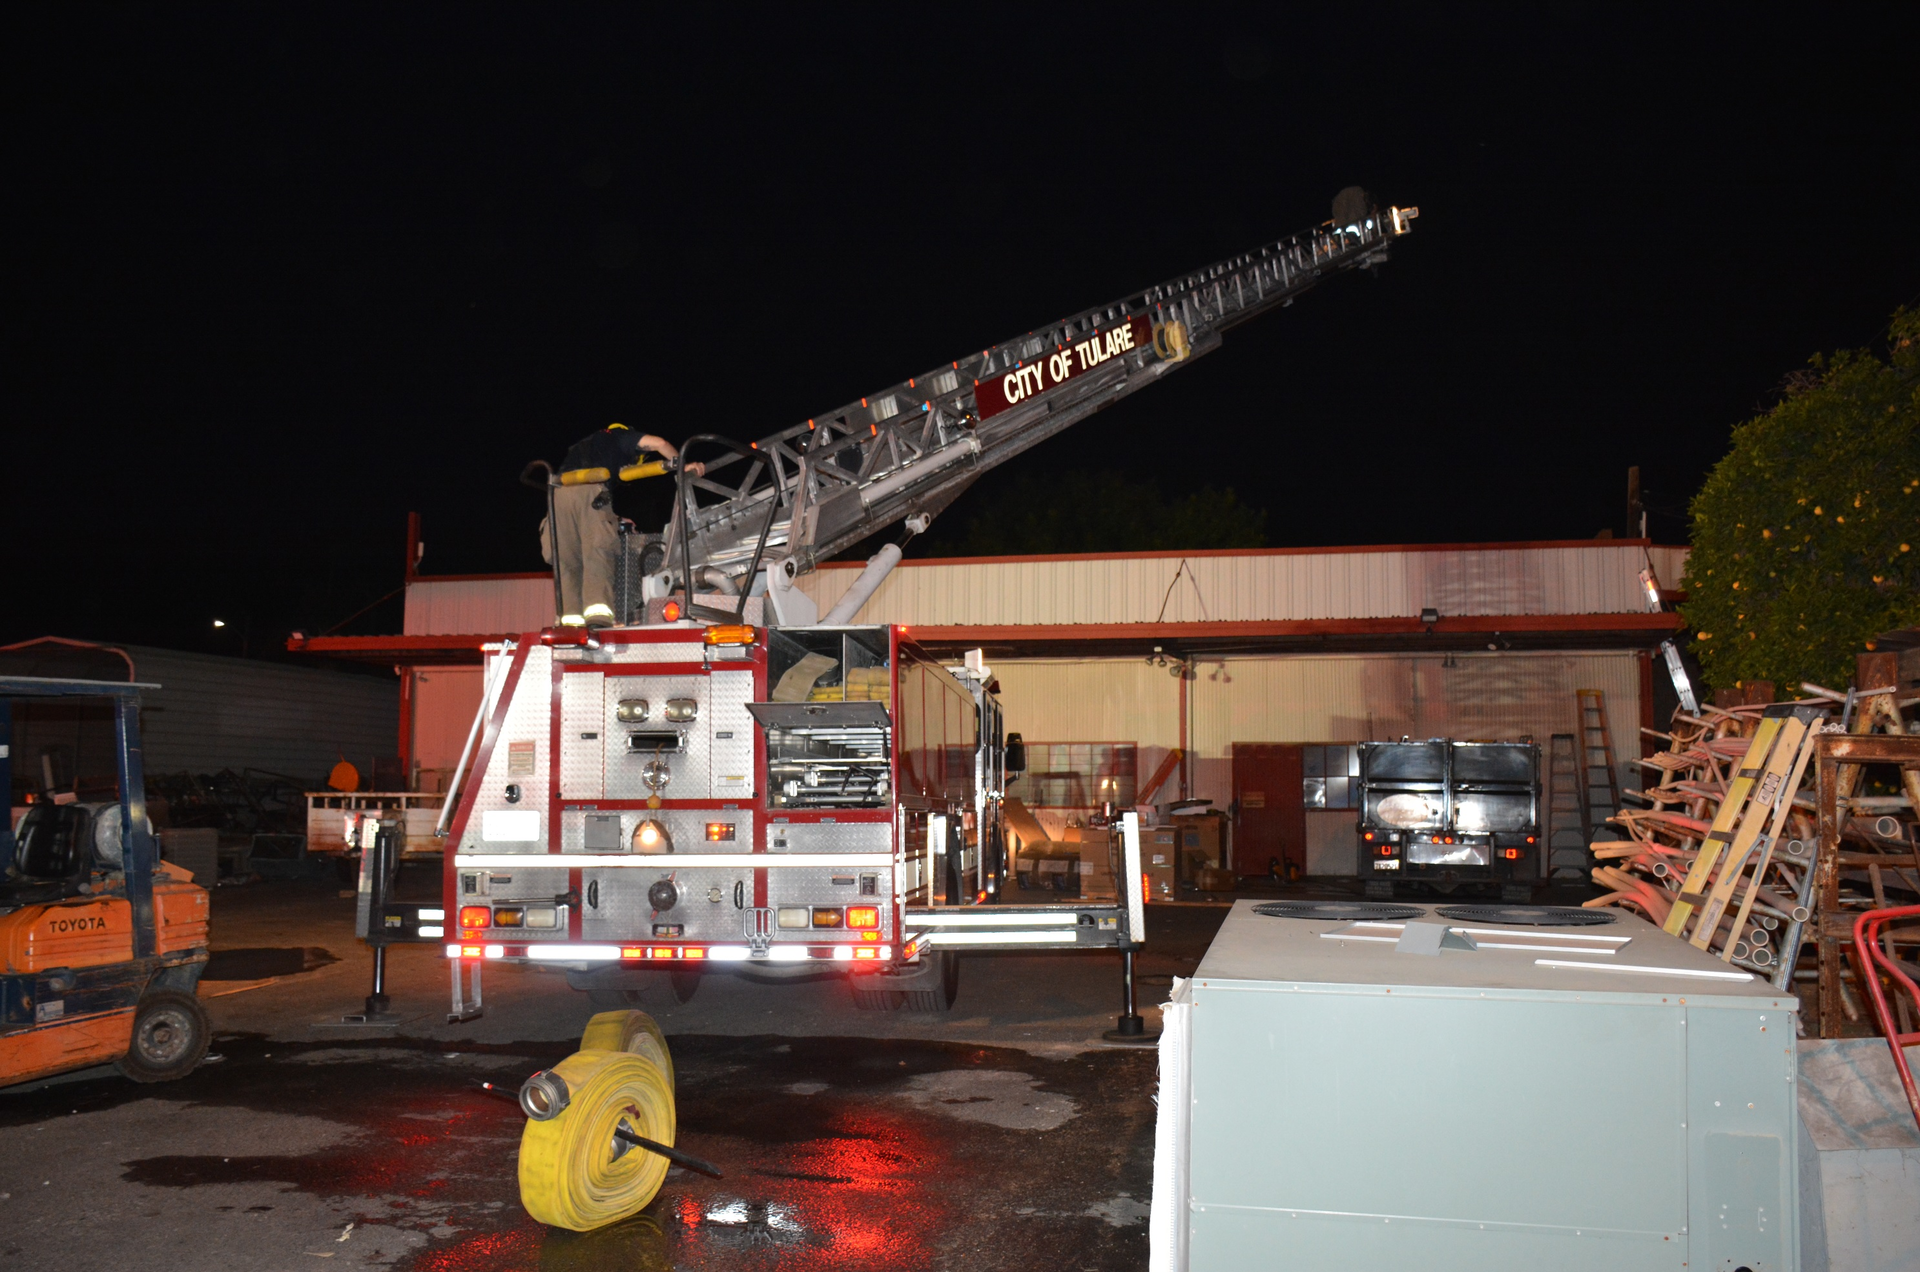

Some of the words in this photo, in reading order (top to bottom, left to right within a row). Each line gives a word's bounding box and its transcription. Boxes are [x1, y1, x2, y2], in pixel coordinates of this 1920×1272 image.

[1003, 361, 1044, 404] CITY
[1049, 349, 1073, 383] OF
[1075, 323, 1135, 370] TULARE
[49, 917, 106, 933] TOYOTA
